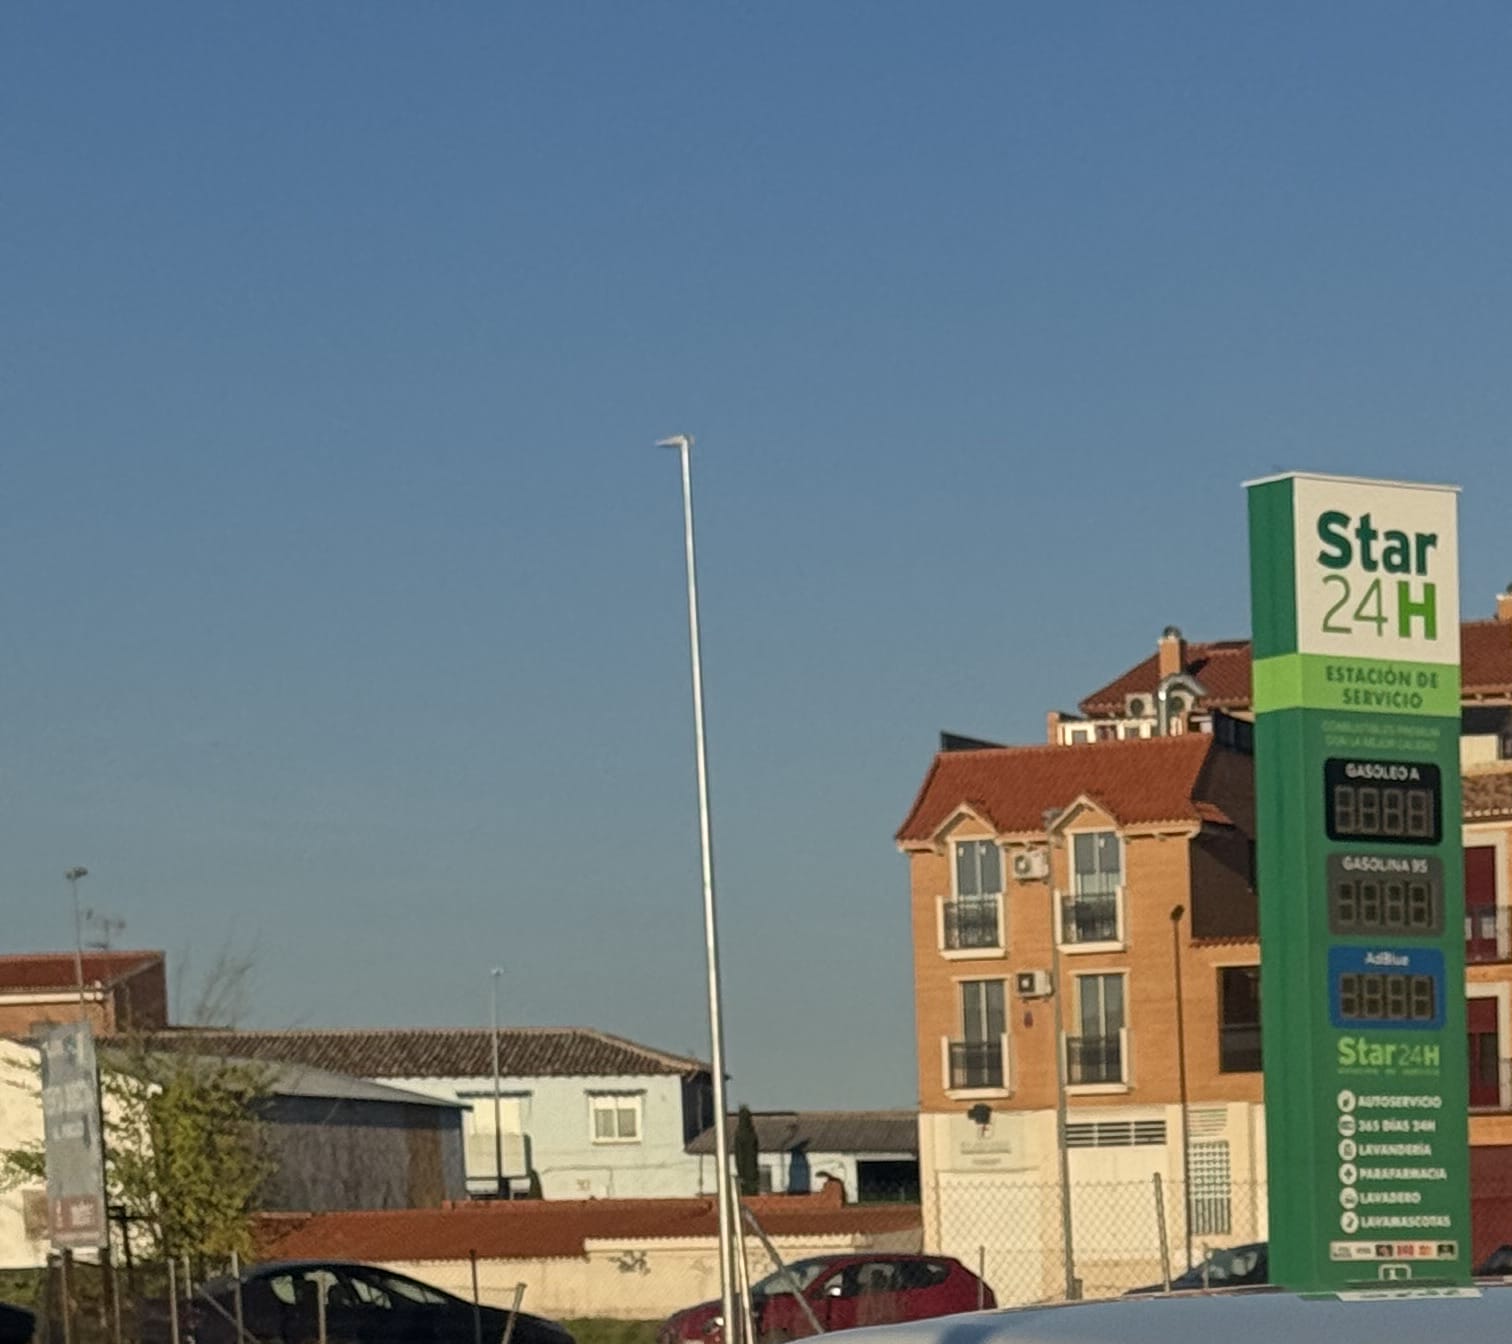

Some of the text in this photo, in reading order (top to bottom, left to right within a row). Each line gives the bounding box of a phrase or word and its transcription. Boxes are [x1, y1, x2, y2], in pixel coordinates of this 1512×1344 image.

[1316, 510, 1438, 576] Star
[1321, 574, 1438, 641] 24H
[1325, 664, 1439, 689] ESTACIÓN DE
[1343, 687, 1424, 709] SERVICIO
[1409, 768, 1420, 781] A
[1342, 856, 1428, 874] GASOLINA 95
[1364, 952, 1410, 967] AdBlue
[1358, 1095, 1442, 1109] AUTOSERVICIO
[1359, 1142, 1432, 1156] LAVANDERÍA
[1359, 1168, 1448, 1180] PARAFARMACIA
[1360, 1192, 1422, 1205] LAVADERO
[1361, 1215, 1452, 1229] LAVAMASCOTAS
